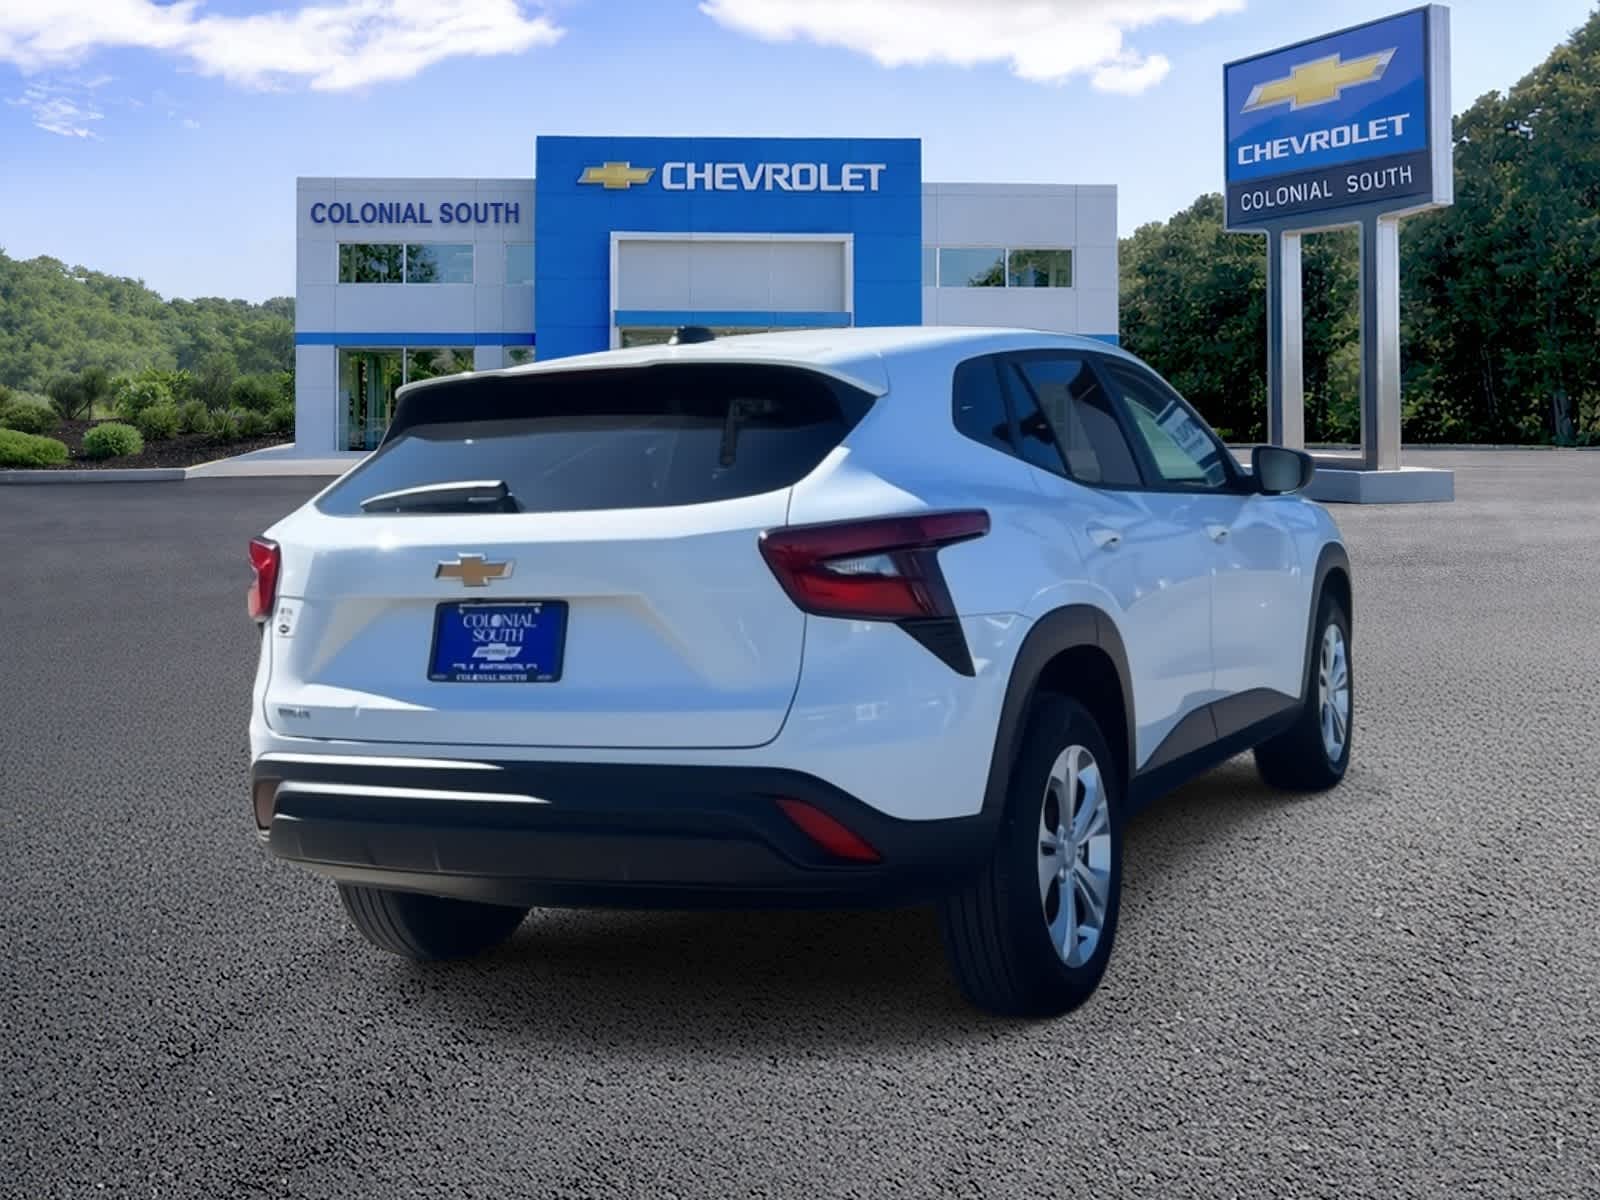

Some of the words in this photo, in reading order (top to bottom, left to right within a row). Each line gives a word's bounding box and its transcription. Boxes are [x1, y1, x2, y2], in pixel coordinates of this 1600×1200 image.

[1238, 113, 1410, 165] CHEVROLET
[662, 162, 887, 191] CHEVROLET
[1241, 180, 1333, 211] COLONIAL
[1347, 165, 1412, 193] SOUTH
[311, 202, 432, 224] COLONIAL
[440, 202, 519, 224] SOUTH
[463, 613, 537, 628] COLONIAL
[472, 628, 524, 642] SOUTH
